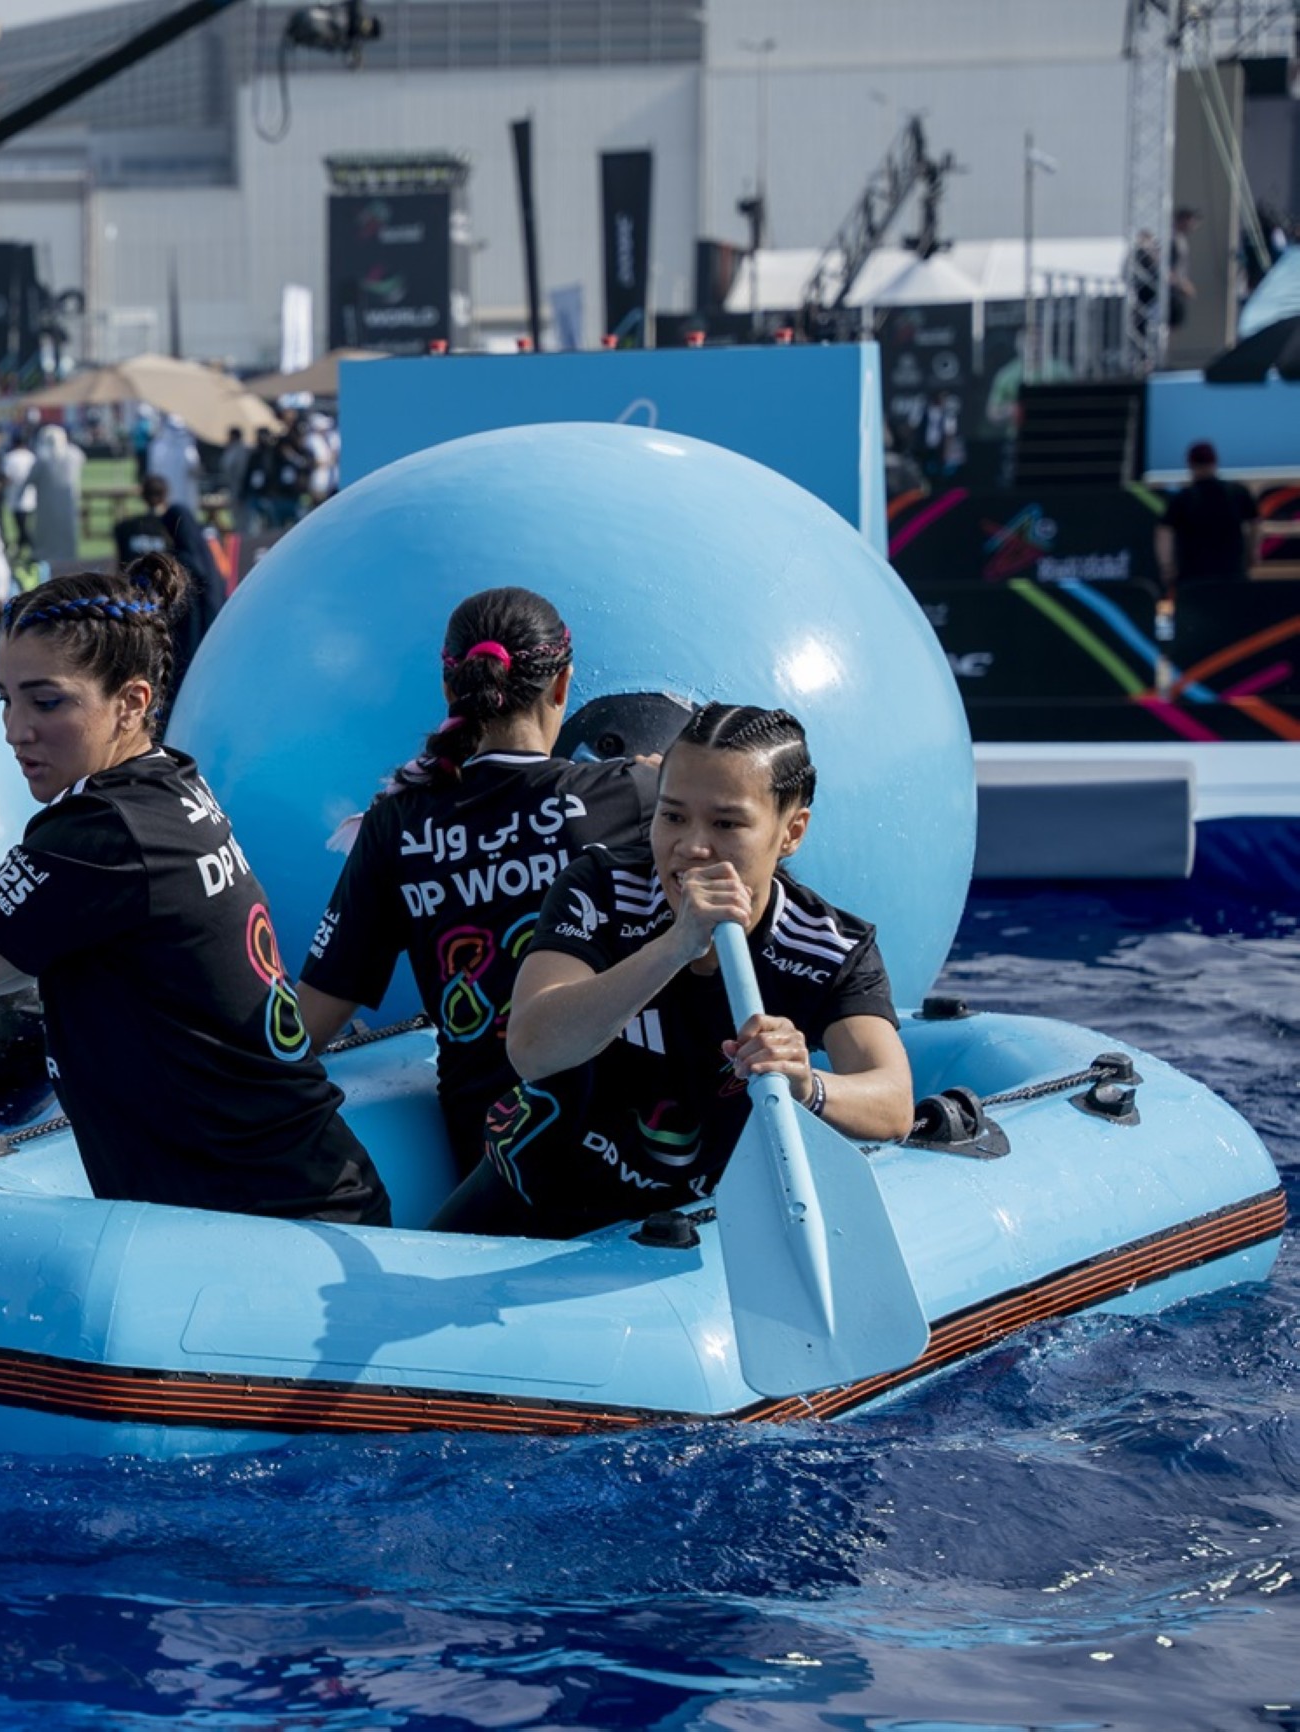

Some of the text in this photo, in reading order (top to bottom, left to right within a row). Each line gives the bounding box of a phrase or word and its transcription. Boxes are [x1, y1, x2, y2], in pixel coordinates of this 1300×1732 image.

[401, 794, 587, 863] دي بي ورلد
[196, 845, 235, 897] DP
[401, 849, 570, 917] DP WORL
[762, 945, 832, 984] DAMAC
[582, 1131, 619, 1166] DP
